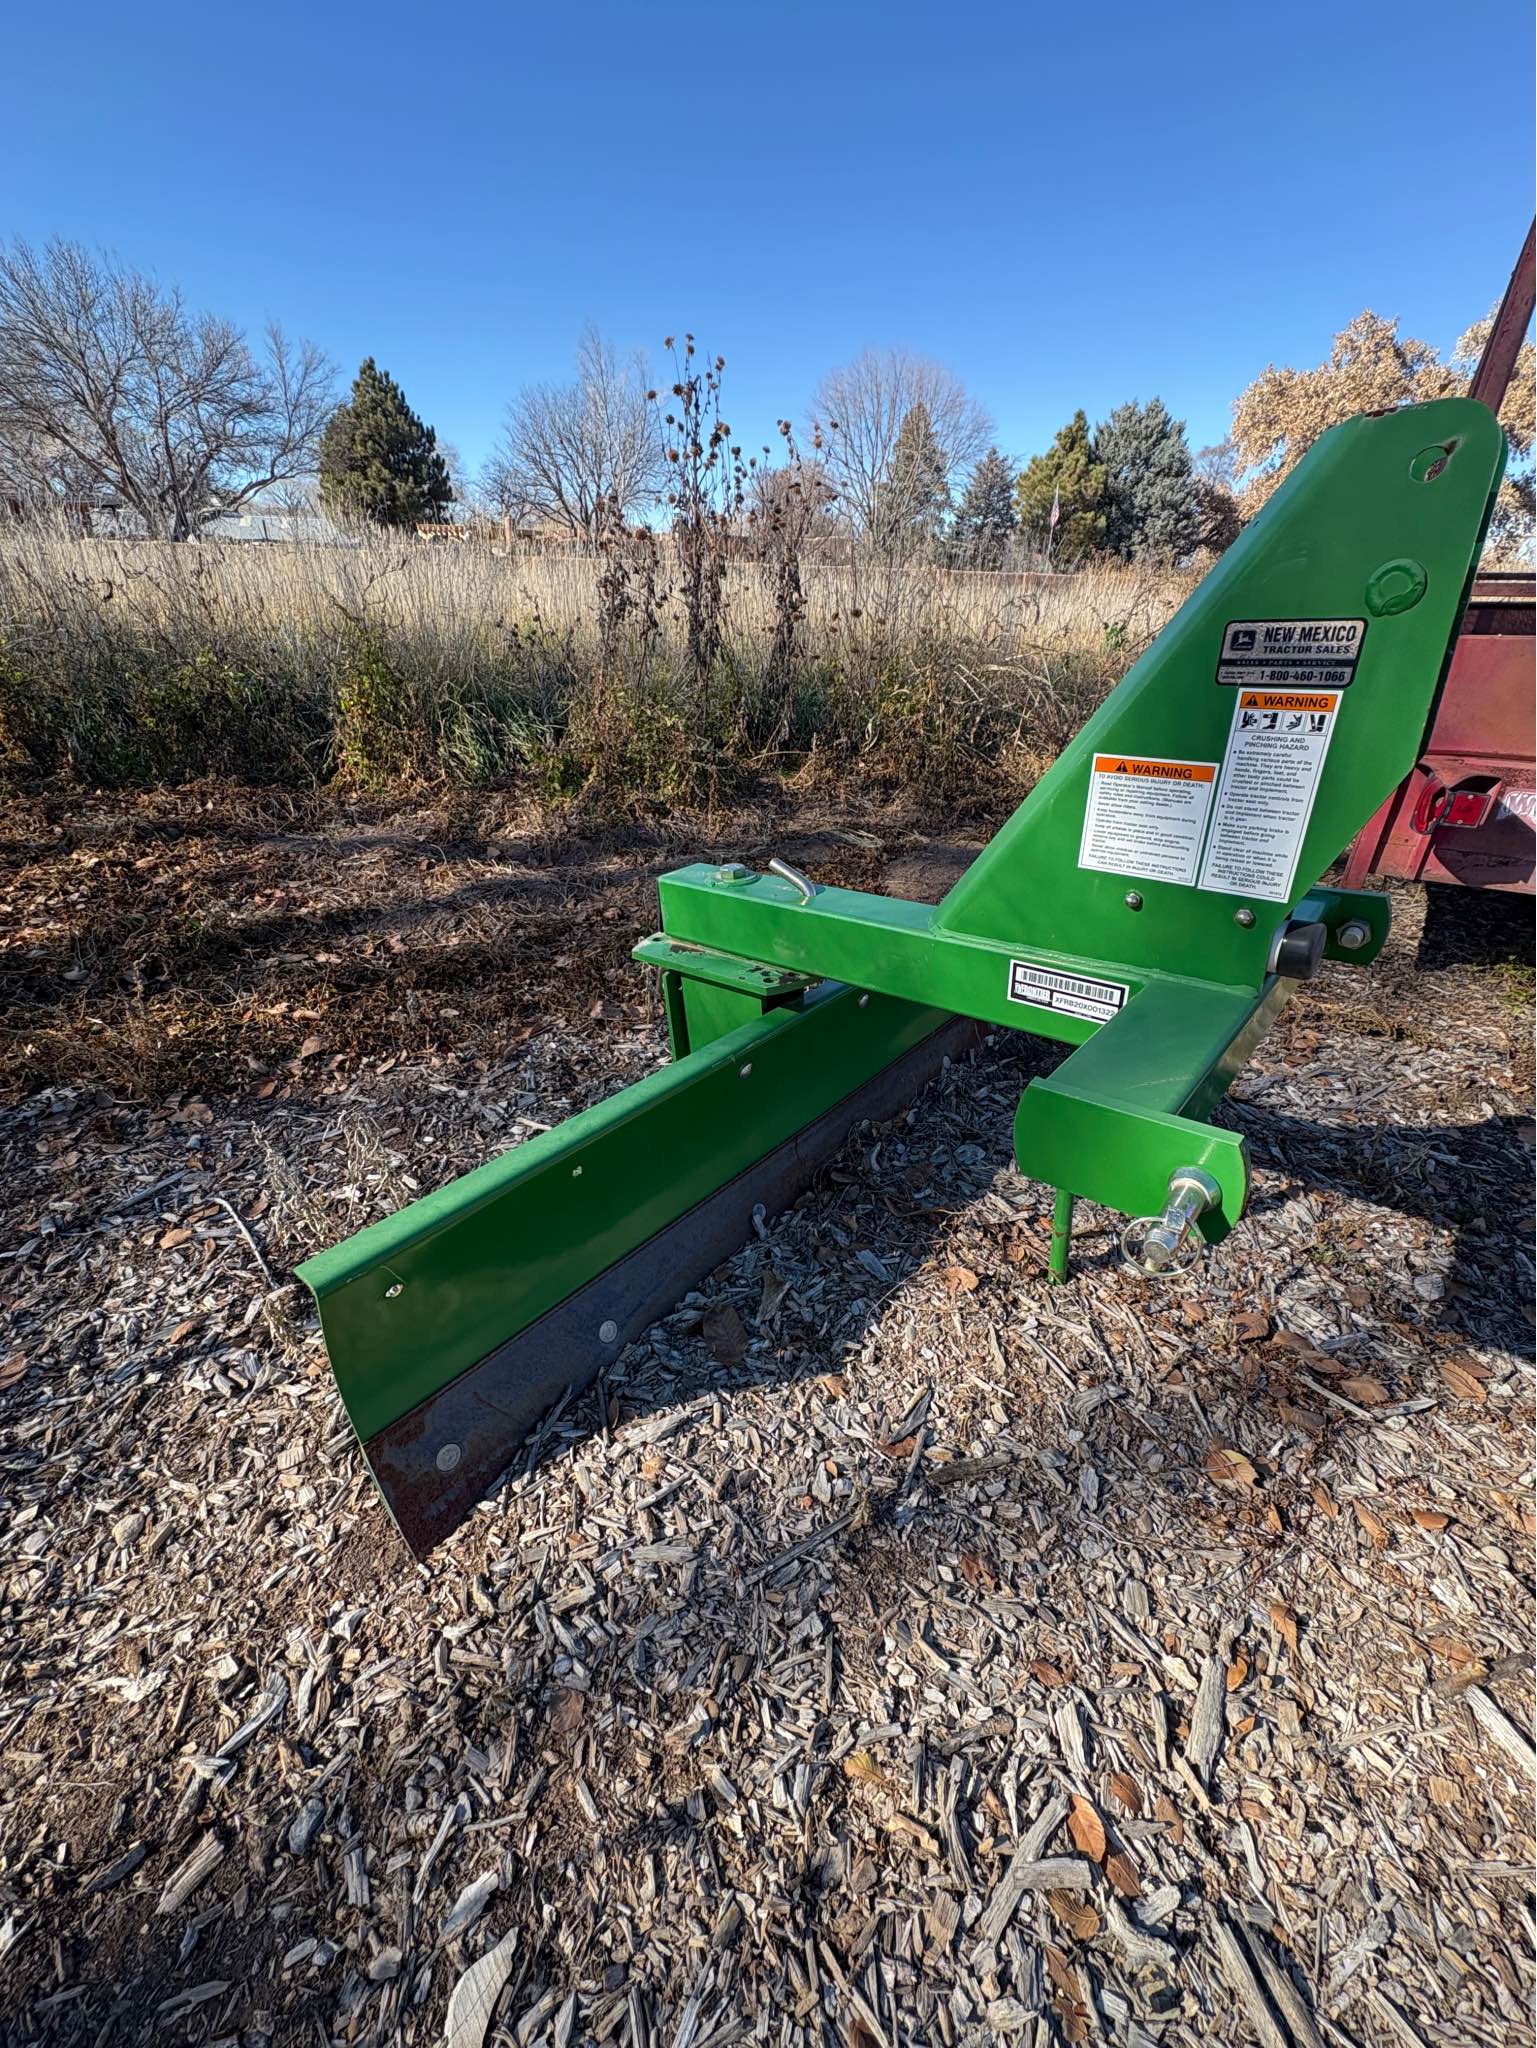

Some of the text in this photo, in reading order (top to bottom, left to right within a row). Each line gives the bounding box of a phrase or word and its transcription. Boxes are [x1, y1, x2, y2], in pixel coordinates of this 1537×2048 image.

[1263, 626, 1356, 642] NEW MEXICO
[1316, 645, 1350, 654] SALES
[1260, 671, 1345, 681] 1-800-460-1066
[1263, 695, 1329, 707] WARNING
[1131, 764, 1193, 778] WARNING
